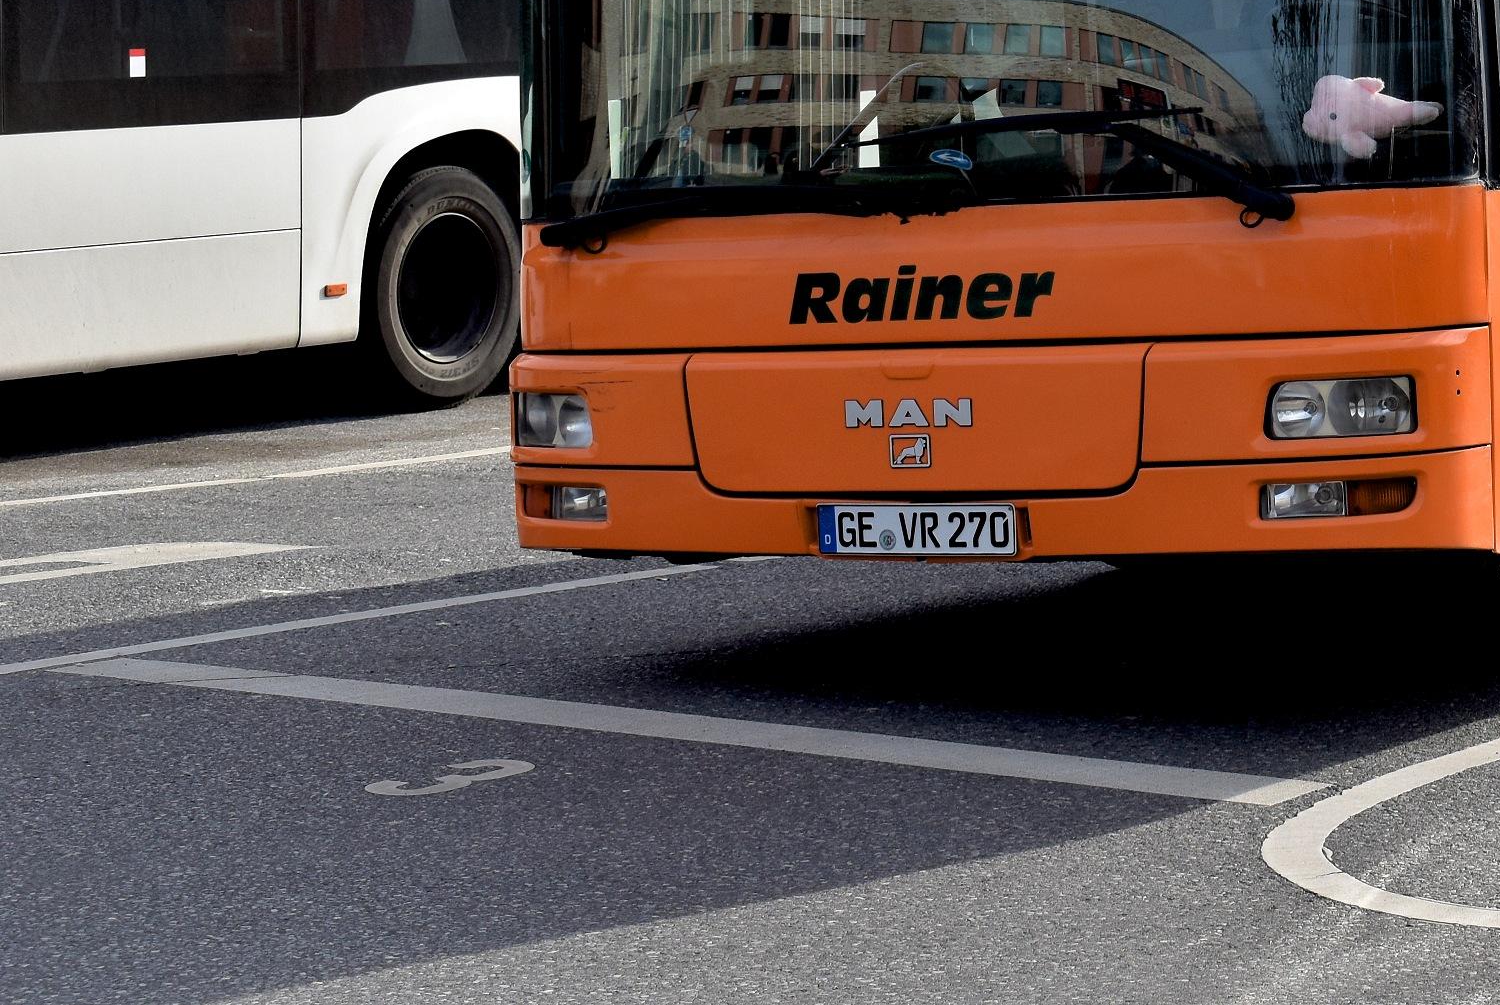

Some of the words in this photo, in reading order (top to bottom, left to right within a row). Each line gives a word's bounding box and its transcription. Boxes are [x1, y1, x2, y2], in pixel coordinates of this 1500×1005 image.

[789, 265, 1056, 324] Rainer
[844, 398, 973, 428] MAN
[837, 512, 878, 548] GE
[899, 512, 941, 548] VR
[947, 511, 1010, 548] 270
[364, 759, 535, 796] 3
